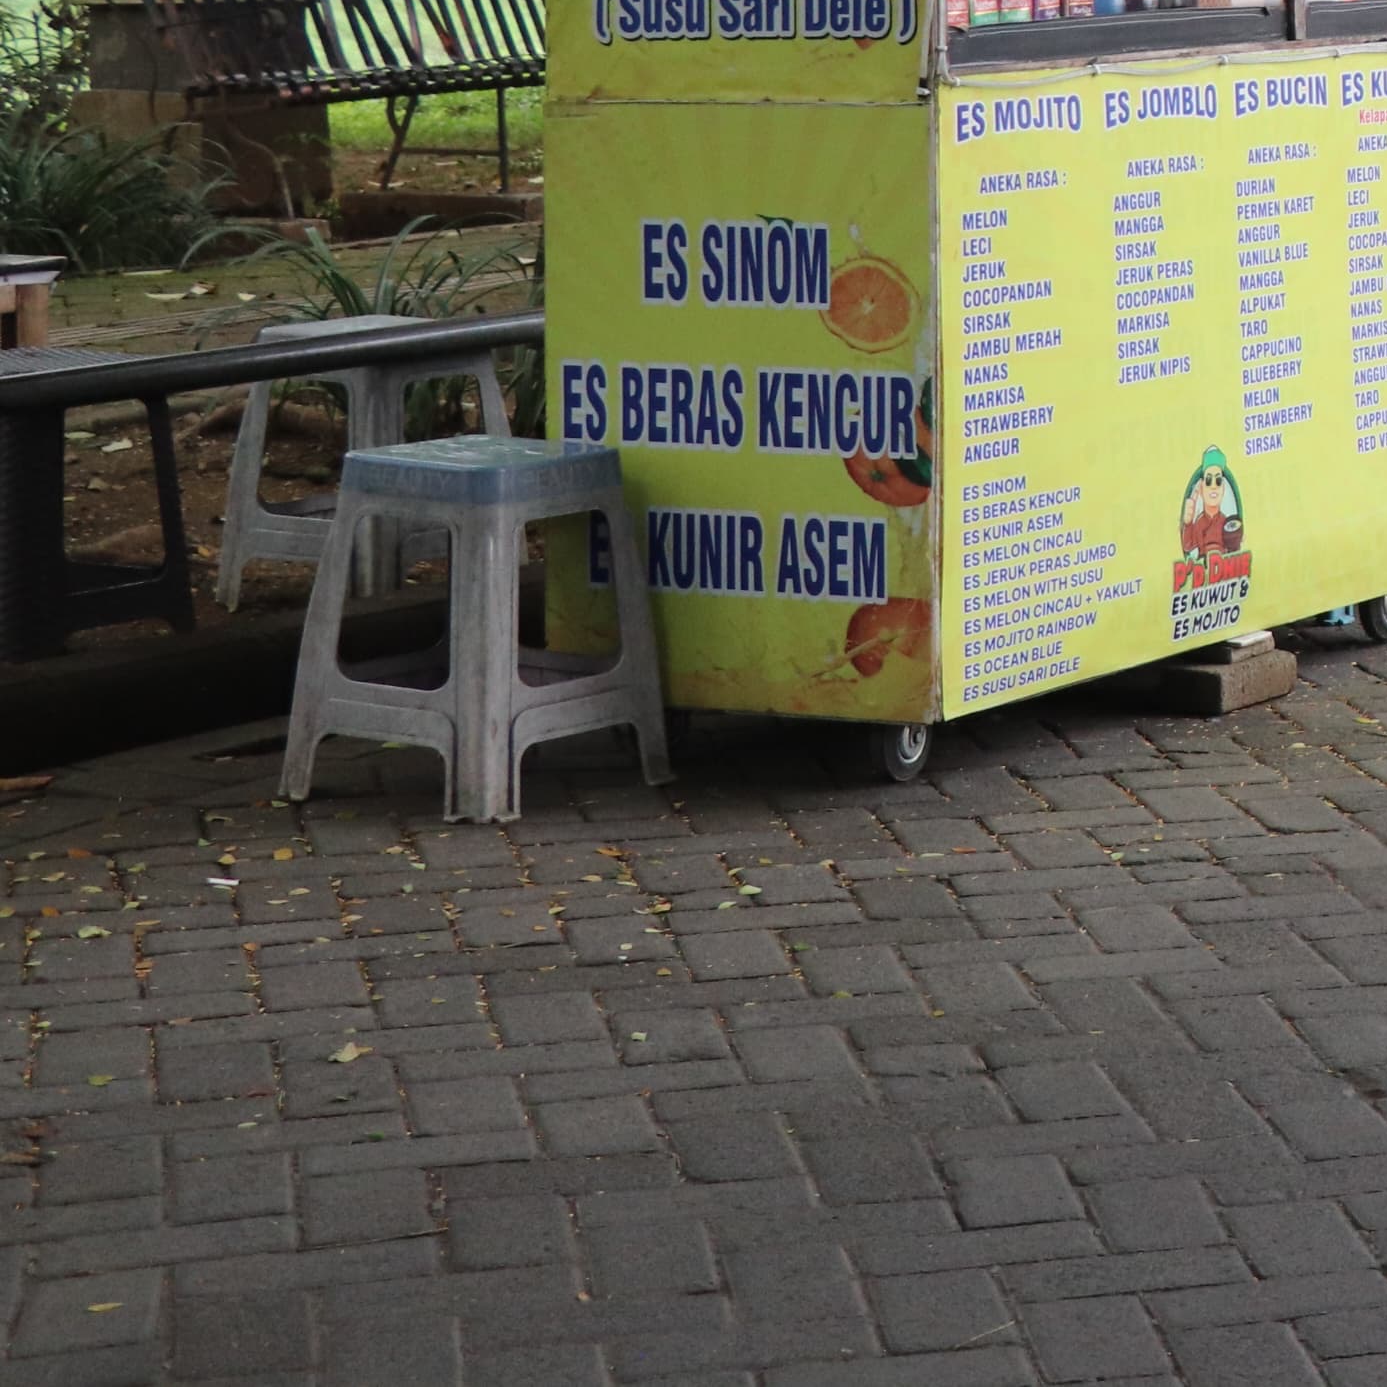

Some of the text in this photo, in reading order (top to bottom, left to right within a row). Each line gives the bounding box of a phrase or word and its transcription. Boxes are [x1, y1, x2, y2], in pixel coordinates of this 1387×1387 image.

[1235, 76, 1327, 117] ES BUCIN
[1342, 72, 1364, 106] ES
[957, 95, 1081, 142] ES MOJITO
[1105, 85, 1217, 128] ES JOMBLO
[962, 210, 1007, 230] MELON
[1236, 196, 1314, 219] PERMEN KARET
[643, 222, 828, 304] ES SINOM
[963, 282, 1051, 308] COCOPANDAN
[1118, 358, 1190, 384] JERUK NIPIS
[1242, 362, 1301, 384] BLUEBERRY
[562, 365, 915, 457] ES BERAS KENCUR
[964, 407, 1054, 437] STRAWBERRY
[1357, 435, 1375, 453] RED
[646, 508, 763, 591] KUNIR
[778, 518, 885, 599] ASEM
[1172, 579, 1248, 616] ES KUWUT &
[1174, 605, 1240, 639] ES MOJITO
[963, 657, 1079, 701] ES SUSU SARI DELE
